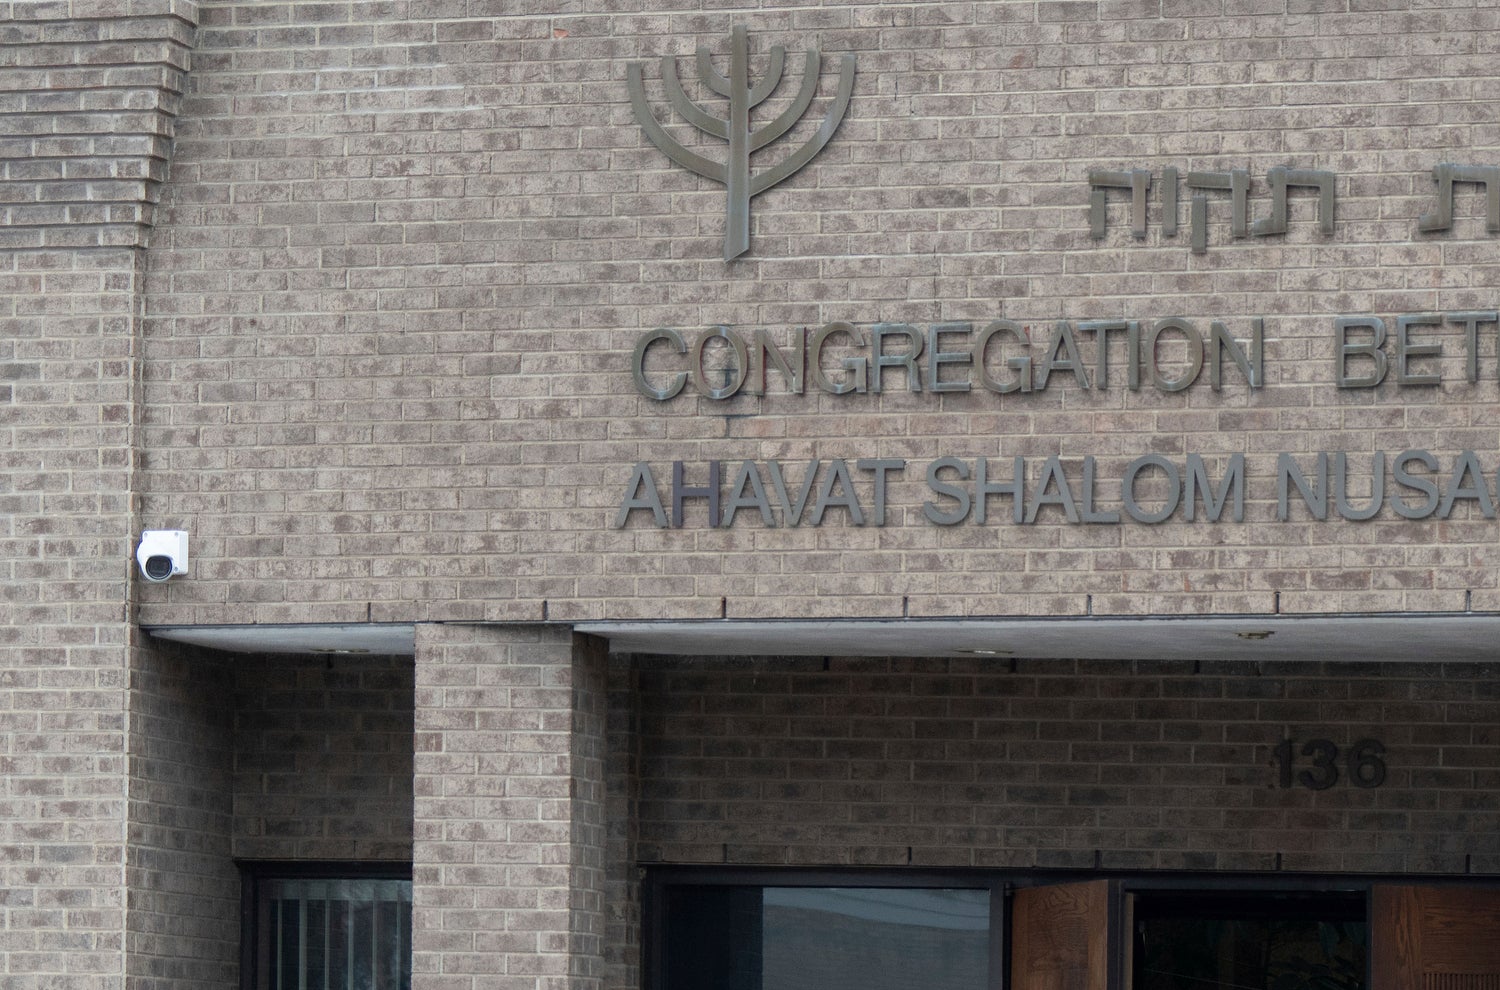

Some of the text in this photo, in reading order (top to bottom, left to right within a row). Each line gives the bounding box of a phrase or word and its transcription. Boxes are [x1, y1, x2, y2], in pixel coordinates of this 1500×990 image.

[1088, 165, 1335, 254] תקוה
[631, 317, 1264, 401] CONGREGATION
[616, 457, 905, 530] AHAVAT
[922, 452, 1245, 527] SHALOM
[1274, 737, 1387, 790] 136
